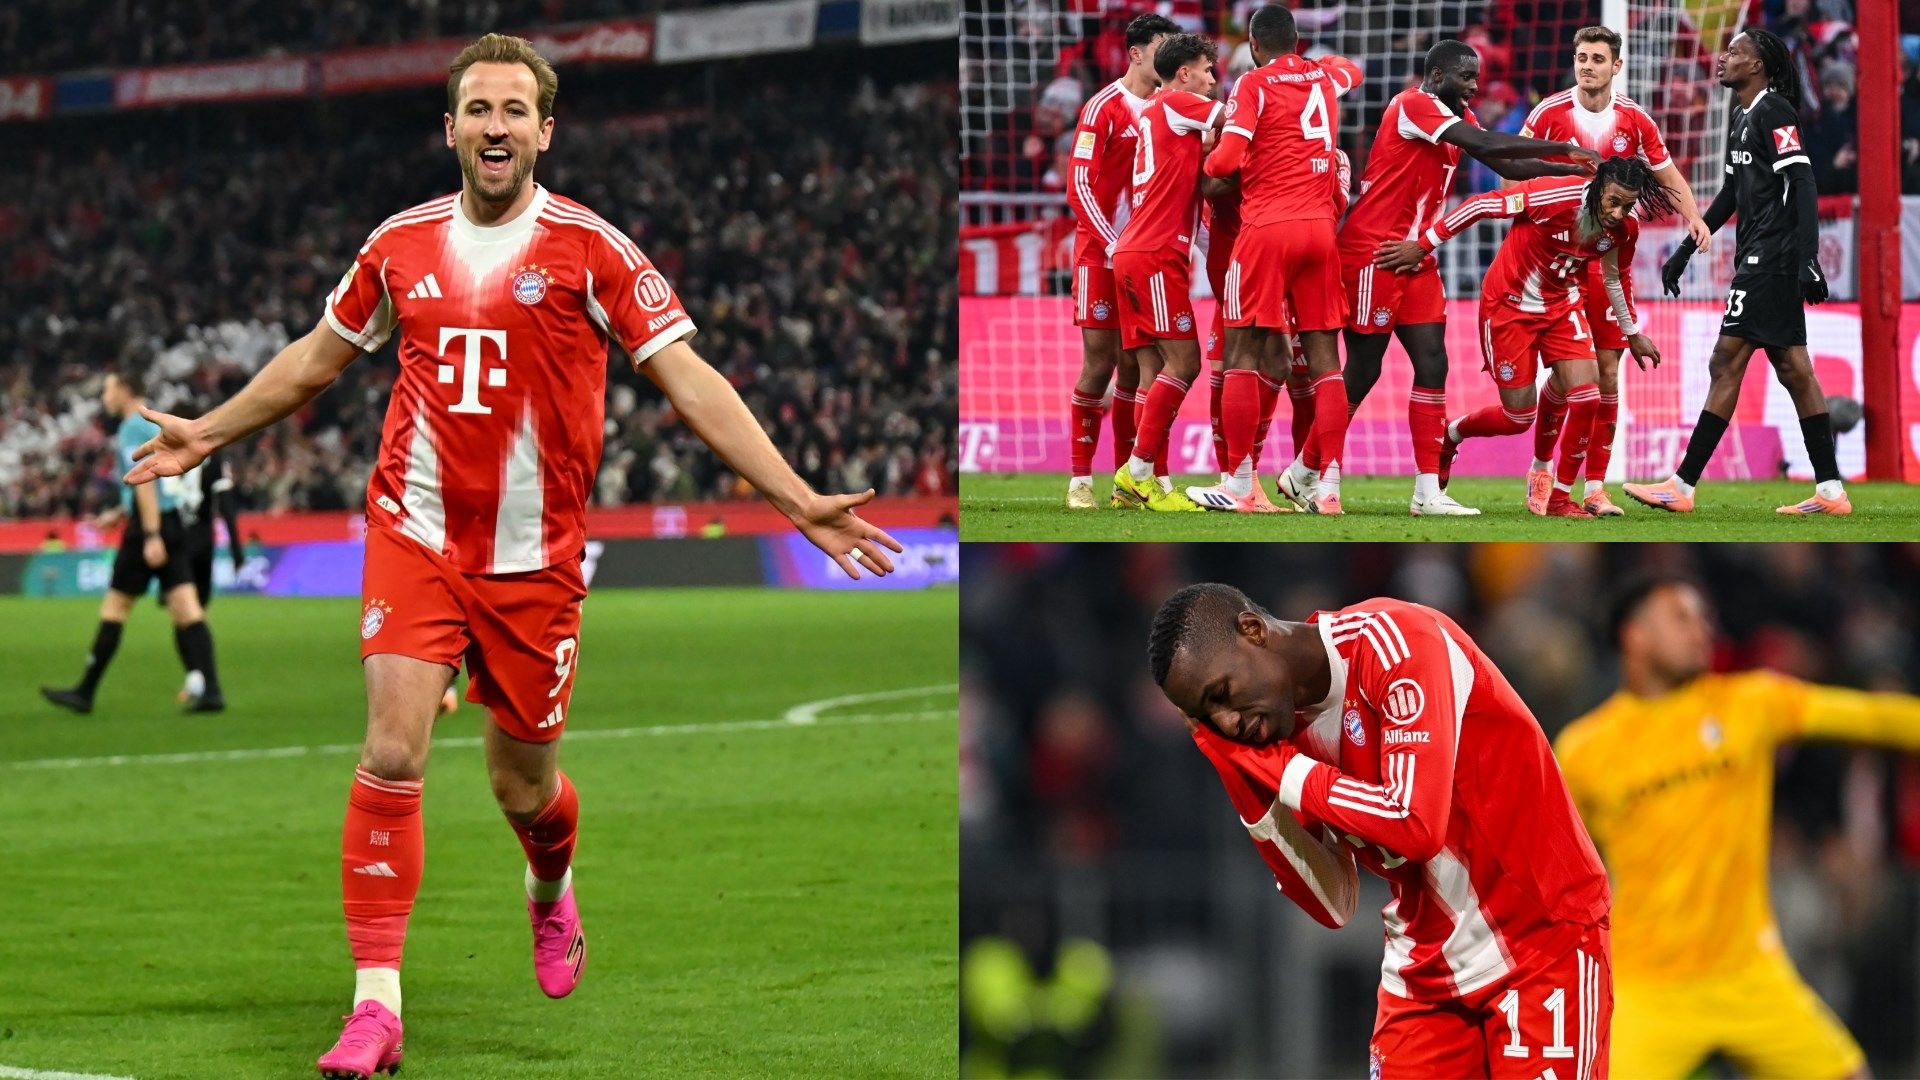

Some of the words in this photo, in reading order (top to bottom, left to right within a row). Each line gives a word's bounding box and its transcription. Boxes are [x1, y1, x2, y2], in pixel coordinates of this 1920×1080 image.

[1299, 83, 1332, 151] 4
[1310, 158, 1329, 173] TAH
[548, 637, 577, 698] 9
[1384, 728, 1431, 745] Allianz
[1497, 987, 1575, 1058] 11
